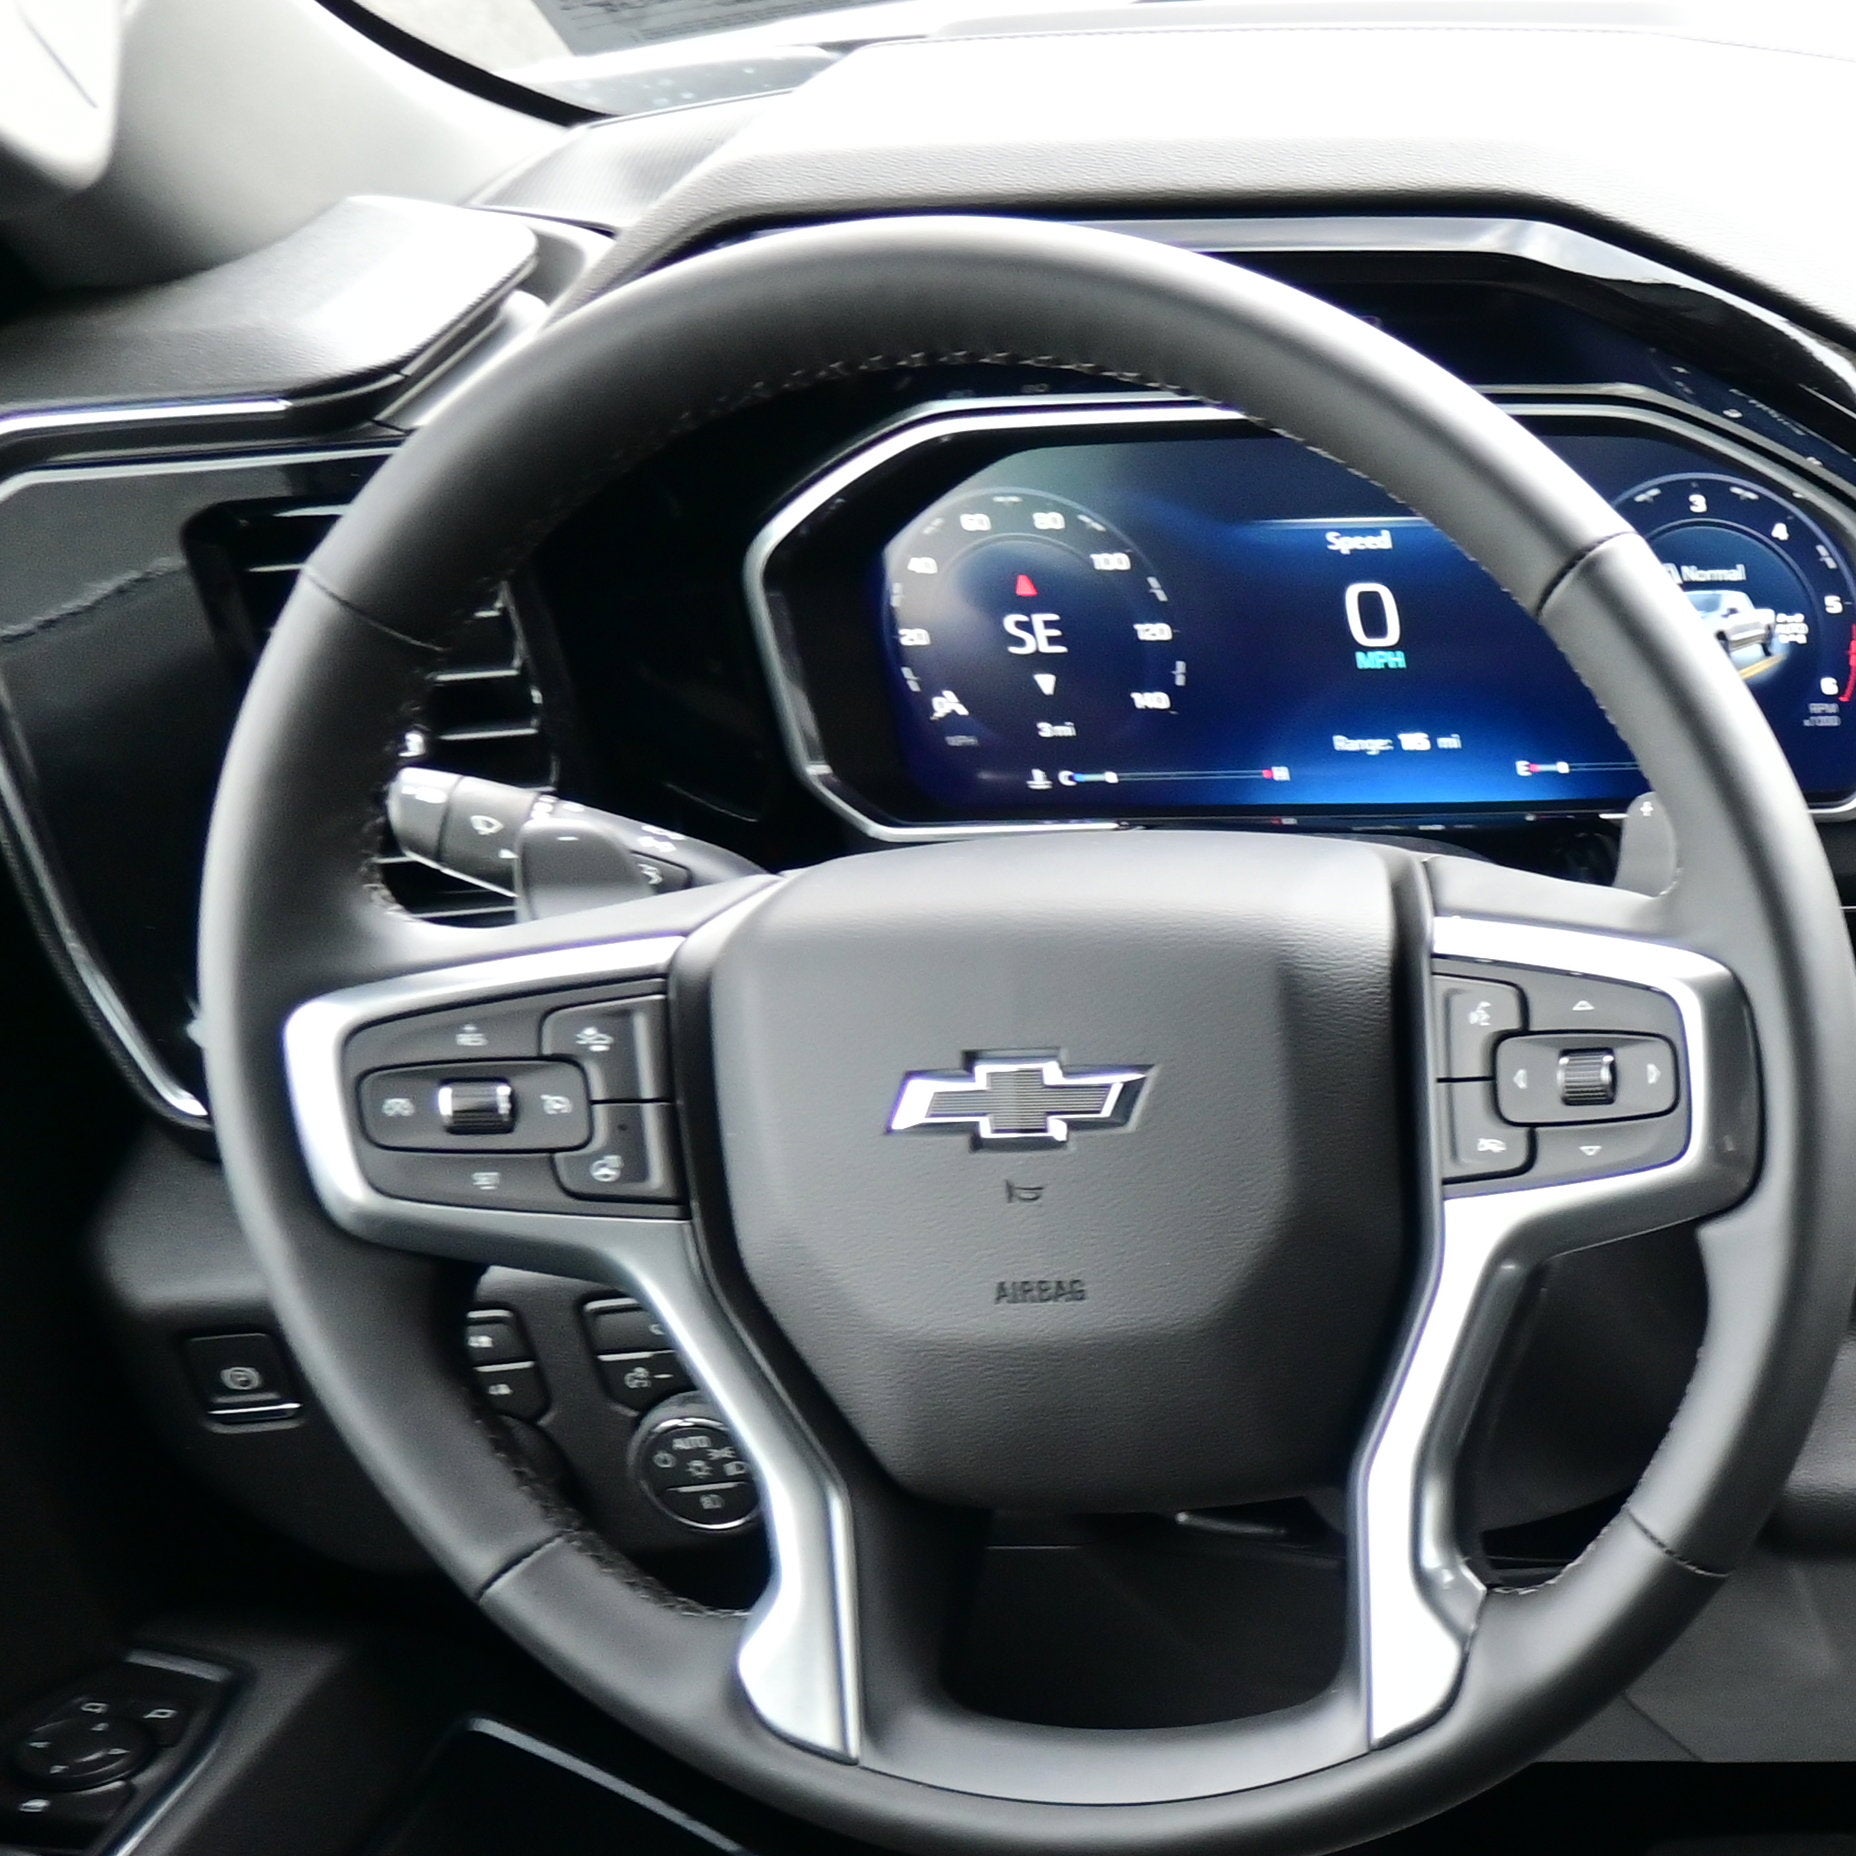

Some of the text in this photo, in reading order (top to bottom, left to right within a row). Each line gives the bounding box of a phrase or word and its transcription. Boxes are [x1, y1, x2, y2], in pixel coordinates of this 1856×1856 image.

[1688, 494, 1707, 513] 3
[960, 513, 991, 531] 60
[1033, 512, 1065, 529] 80
[1771, 522, 1790, 541] 4
[1325, 529, 1393, 555] Speed
[907, 556, 938, 574] 40
[1090, 552, 1131, 570] 100
[1681, 563, 1747, 583] Normal
[1823, 594, 1843, 614] 5
[1345, 582, 1401, 647] 0
[899, 628, 931, 646] 20
[1002, 612, 1069, 655] SE
[1133, 622, 1173, 641] 120
[1355, 650, 1407, 669] MPH
[1820, 676, 1839, 696] 6
[1130, 691, 1171, 709] 140
[1332, 735, 1394, 756] Range:
[1437, 734, 1462, 749] mi
[995, 1279, 1087, 1304] AIRBAG
